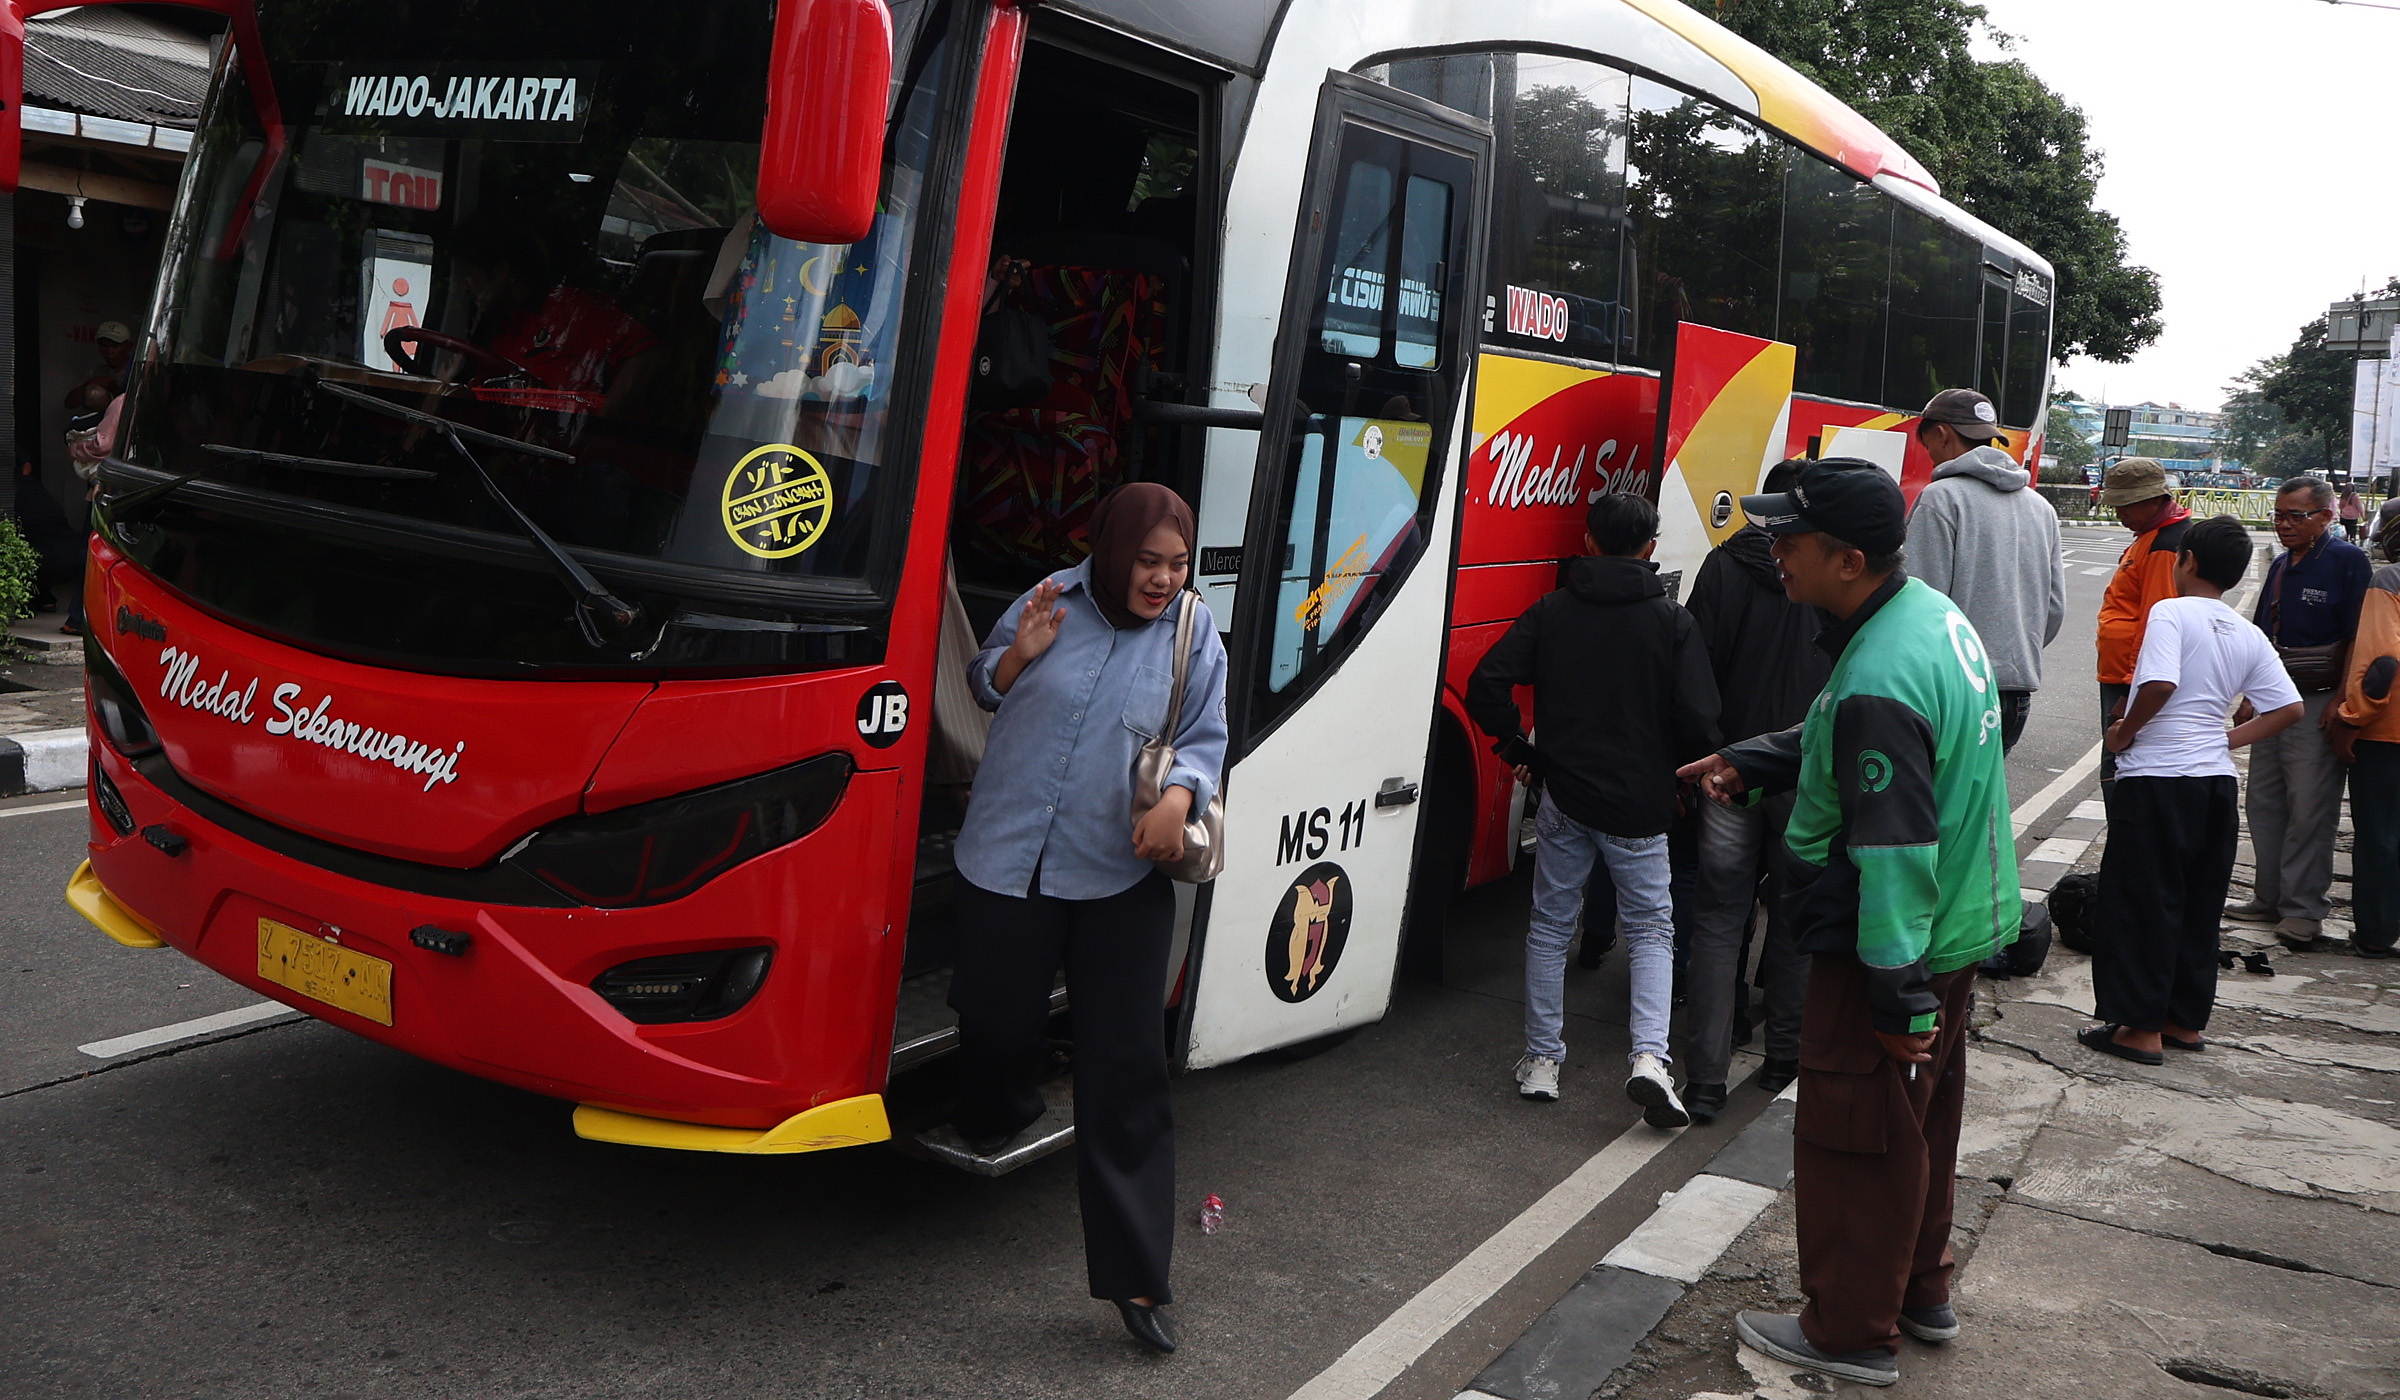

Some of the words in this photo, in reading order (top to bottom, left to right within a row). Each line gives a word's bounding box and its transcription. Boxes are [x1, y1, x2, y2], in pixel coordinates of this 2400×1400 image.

[344, 75, 577, 122] WADO-JAKARTA
[1507, 284, 1569, 343] WADO
[1488, 429, 1586, 509] Medal
[1587, 438, 1650, 505] Seka
[160, 645, 259, 724] Medal
[265, 682, 466, 792] Sekarwangi
[857, 693, 908, 734] JB
[1275, 806, 1332, 867] MS
[1338, 798, 1367, 852] 11
[261, 923, 273, 960] Z
